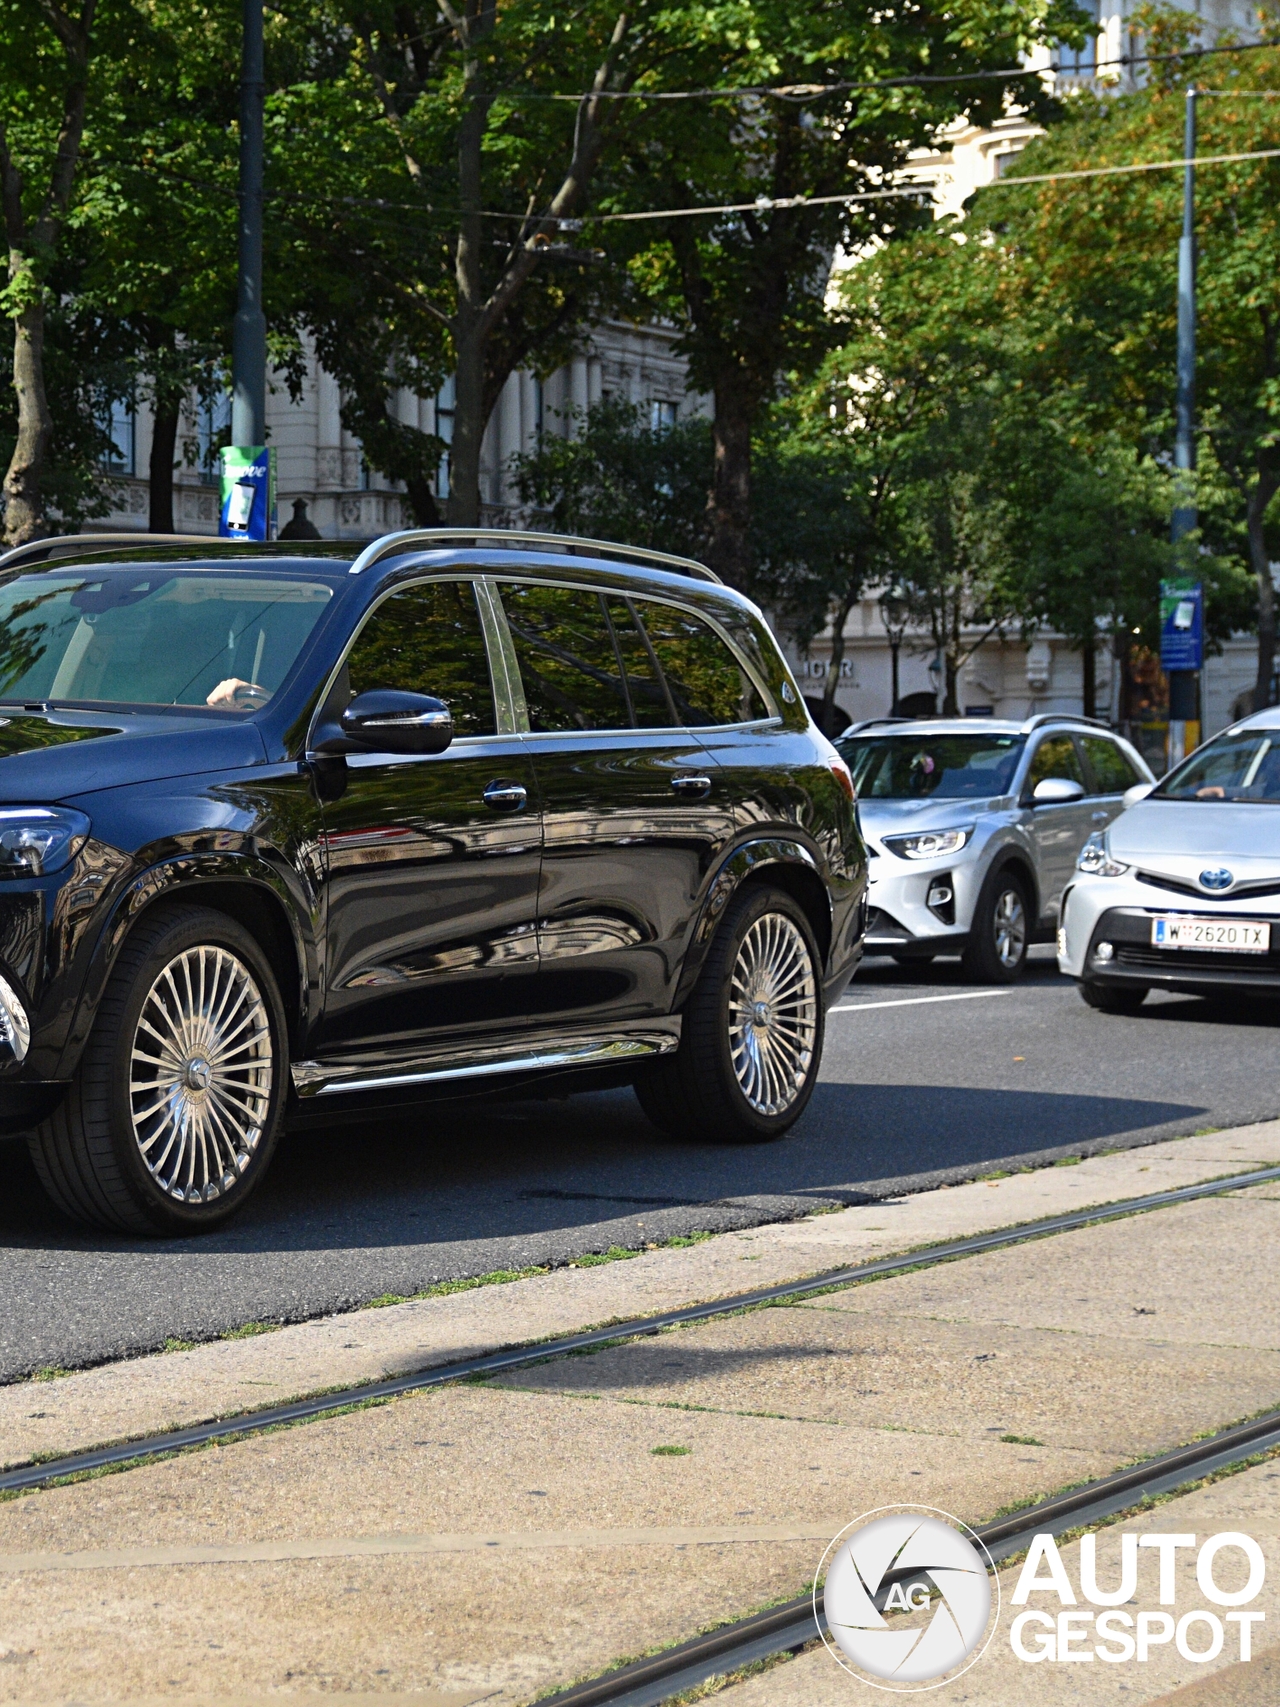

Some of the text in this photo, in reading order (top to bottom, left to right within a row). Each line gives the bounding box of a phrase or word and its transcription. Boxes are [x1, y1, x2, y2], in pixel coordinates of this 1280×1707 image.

[1170, 925, 1262, 944] W 2620 TX
